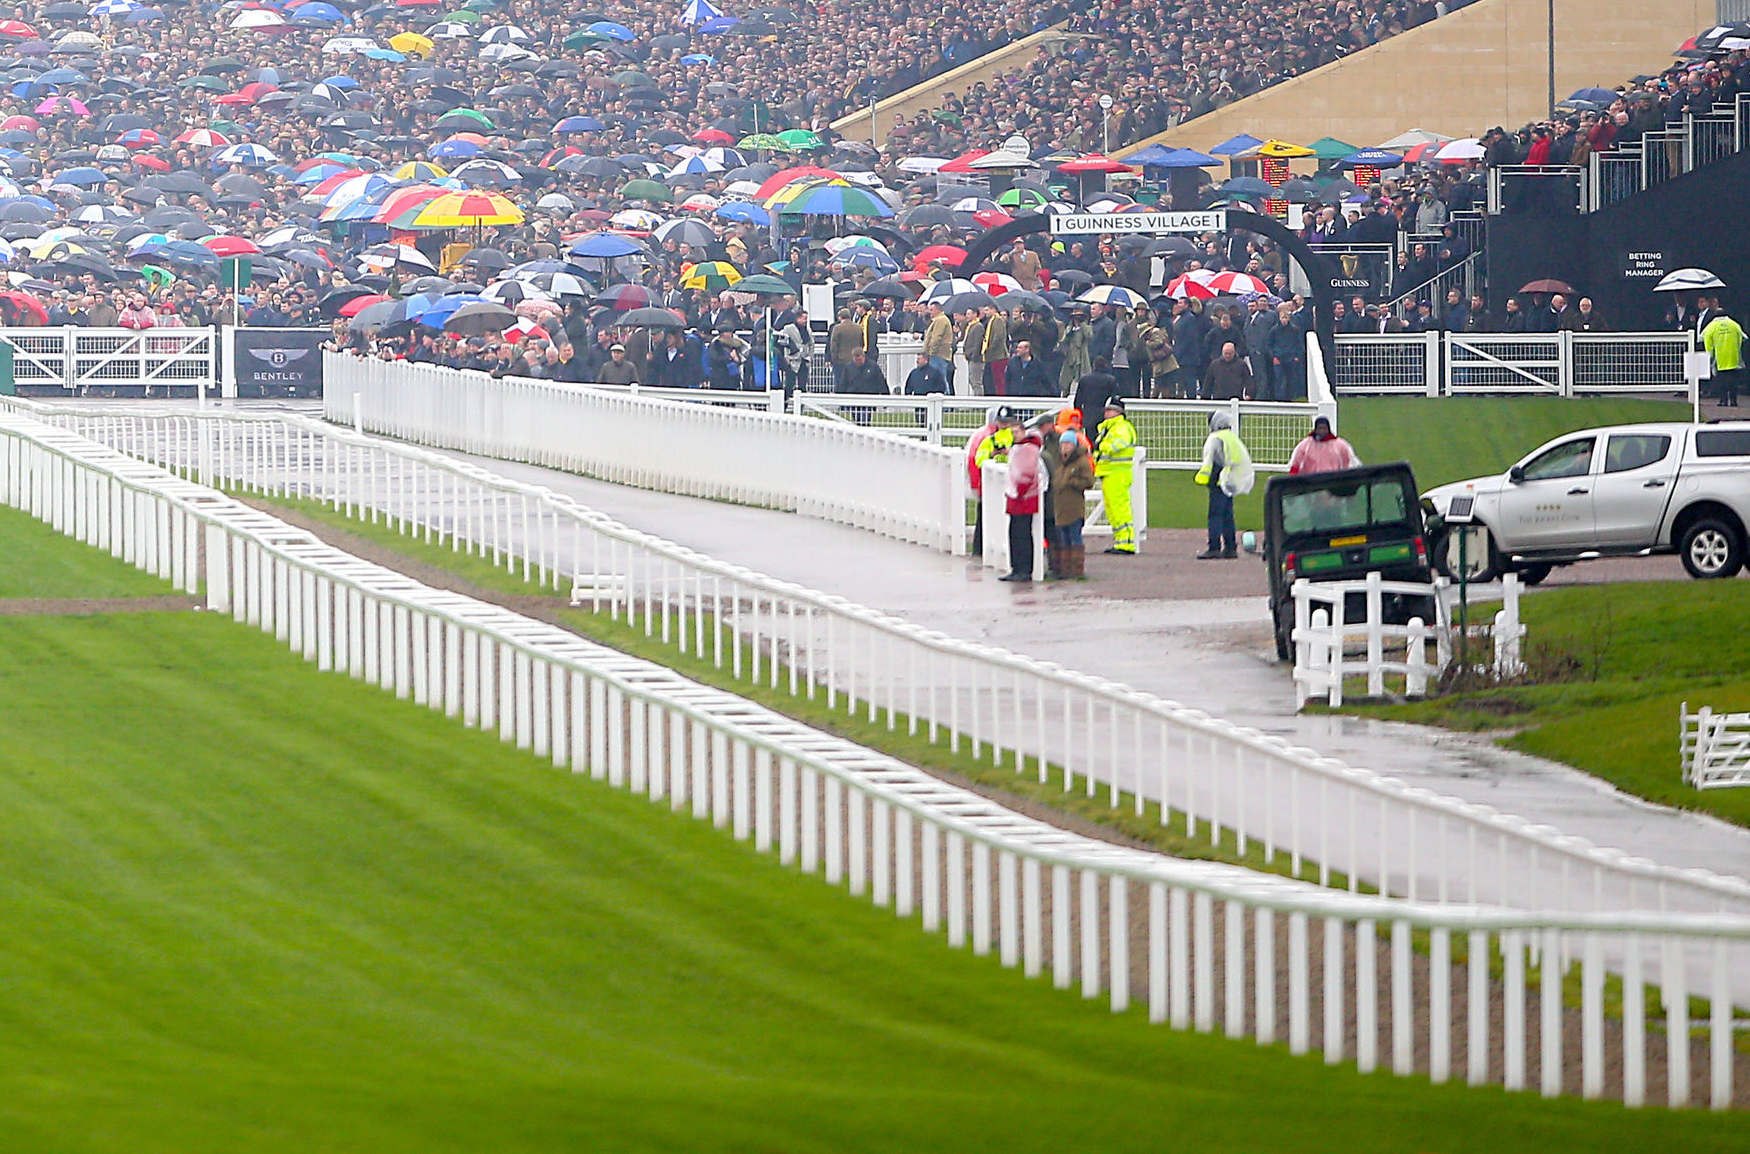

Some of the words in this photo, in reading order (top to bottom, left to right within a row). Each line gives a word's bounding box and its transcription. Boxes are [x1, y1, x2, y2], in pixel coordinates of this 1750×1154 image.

[1065, 217, 1142, 229] GUINNESS
[1147, 215, 1211, 228] VILLAGE
[1629, 252, 1662, 260] BETTING
[1625, 269, 1664, 277] MANAGER
[1330, 278, 1370, 287] GUINNESS
[253, 372, 304, 381] BENTLEY
